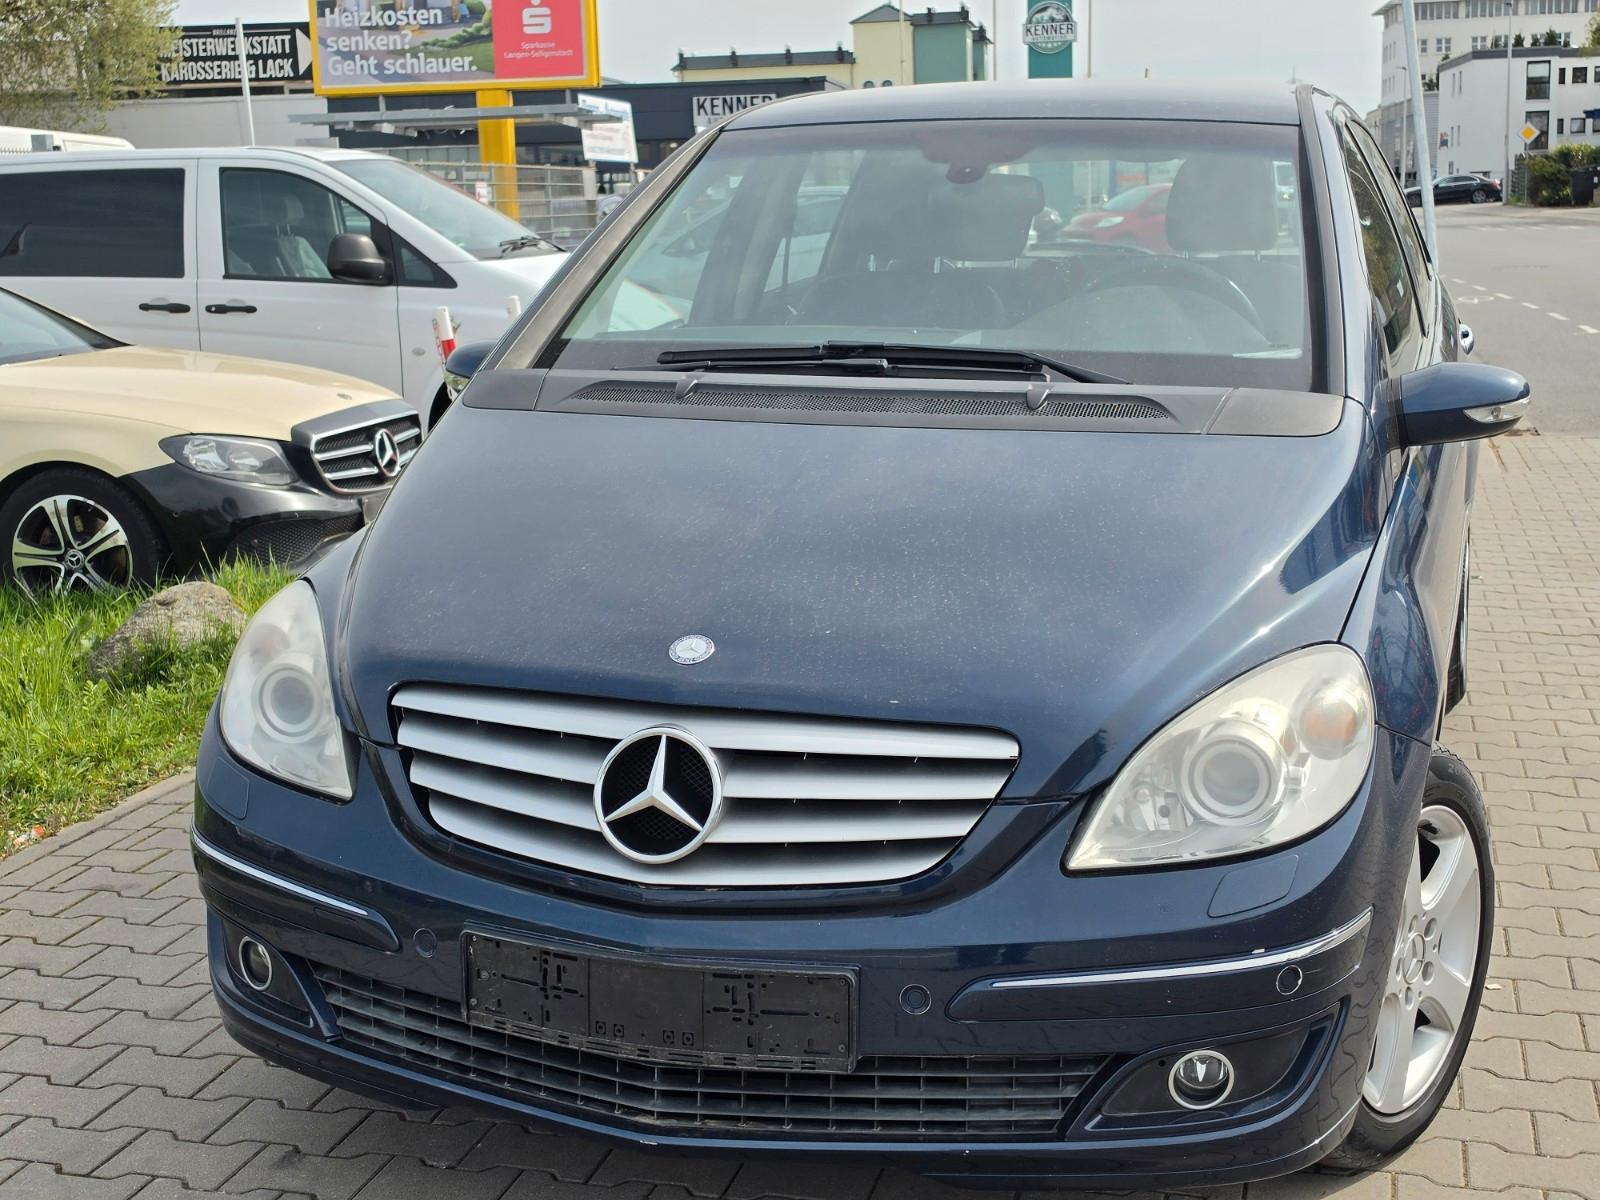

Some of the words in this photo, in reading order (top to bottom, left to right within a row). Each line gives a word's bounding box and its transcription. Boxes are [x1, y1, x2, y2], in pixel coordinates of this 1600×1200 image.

[324, 6, 443, 28] Heizkosten
[326, 30, 413, 52] senken?
[1025, 23, 1073, 37] KENNER
[159, 35, 292, 58] EISTERWEKSTATT
[258, 57, 295, 79] LACK
[328, 54, 379, 76] Geht
[383, 52, 478, 75] schlauer.
